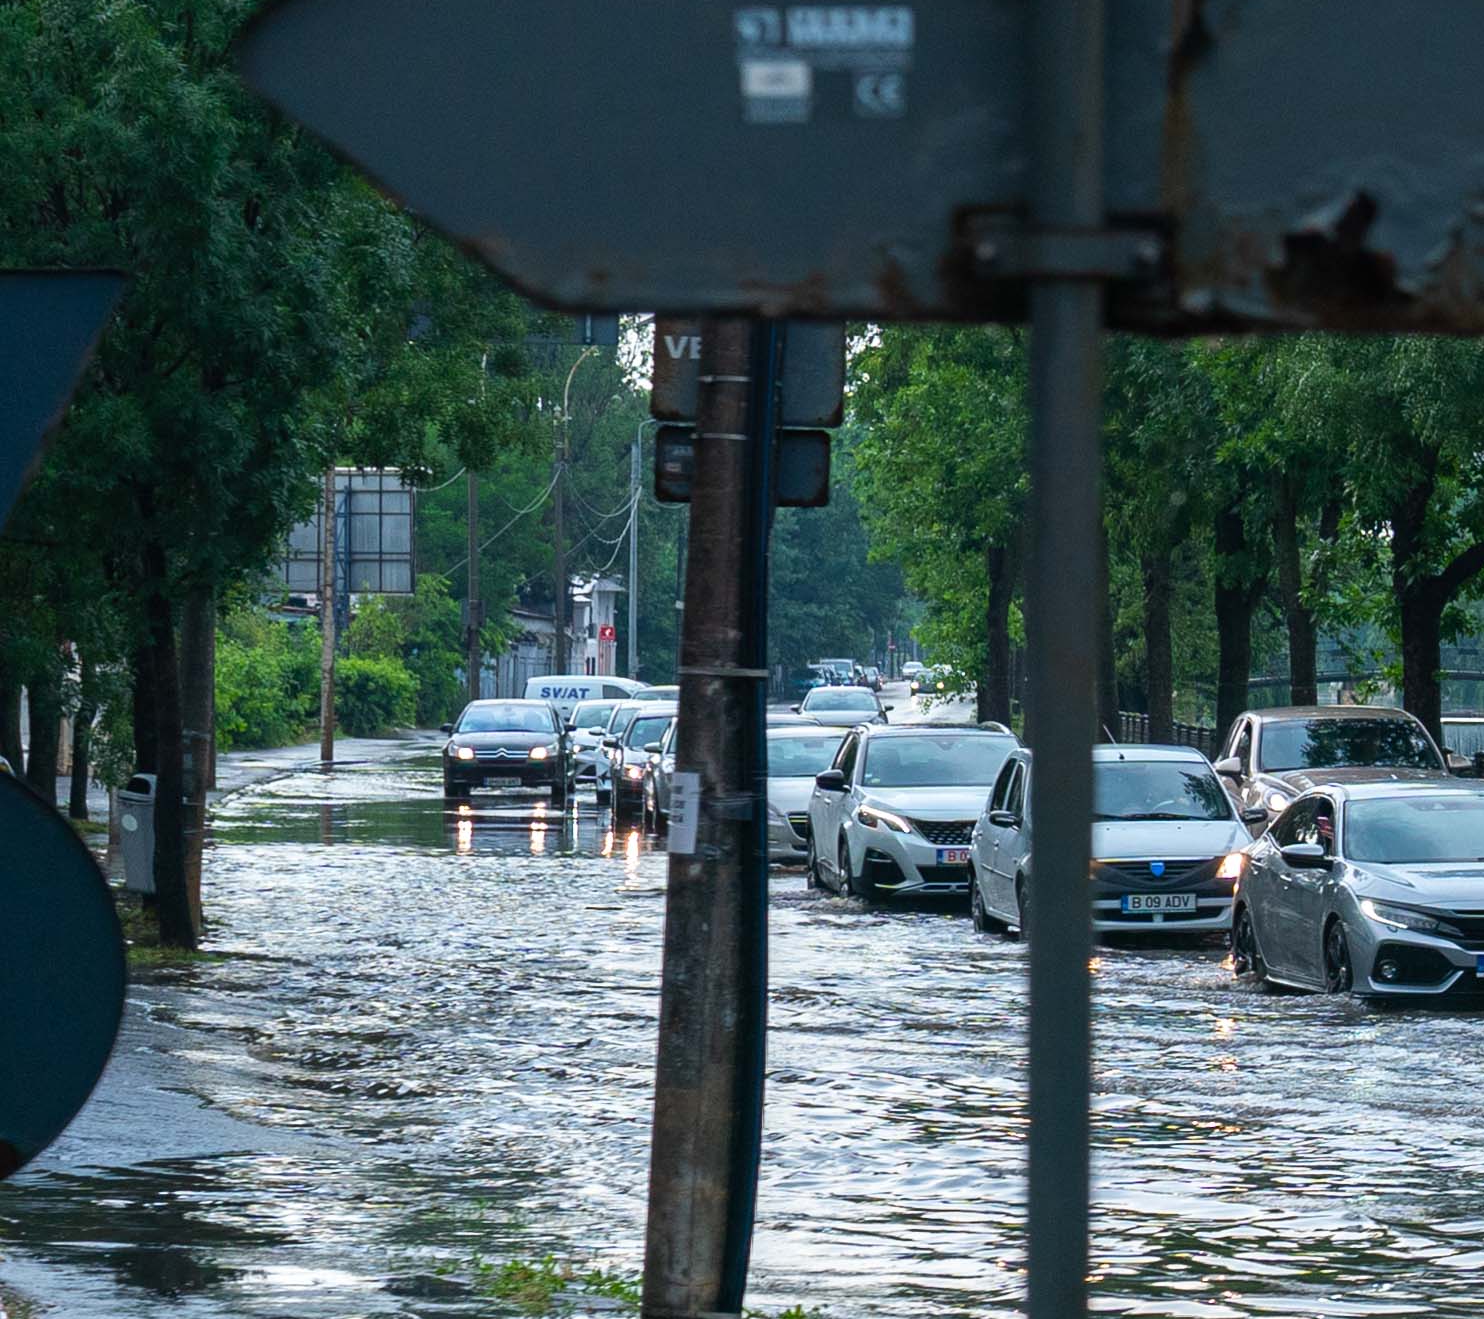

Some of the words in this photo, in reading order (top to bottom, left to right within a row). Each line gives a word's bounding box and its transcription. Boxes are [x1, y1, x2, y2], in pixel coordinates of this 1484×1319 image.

[1132, 897, 1141, 909] B
[1145, 896, 1161, 908] 09
[1165, 895, 1190, 908] ADV
